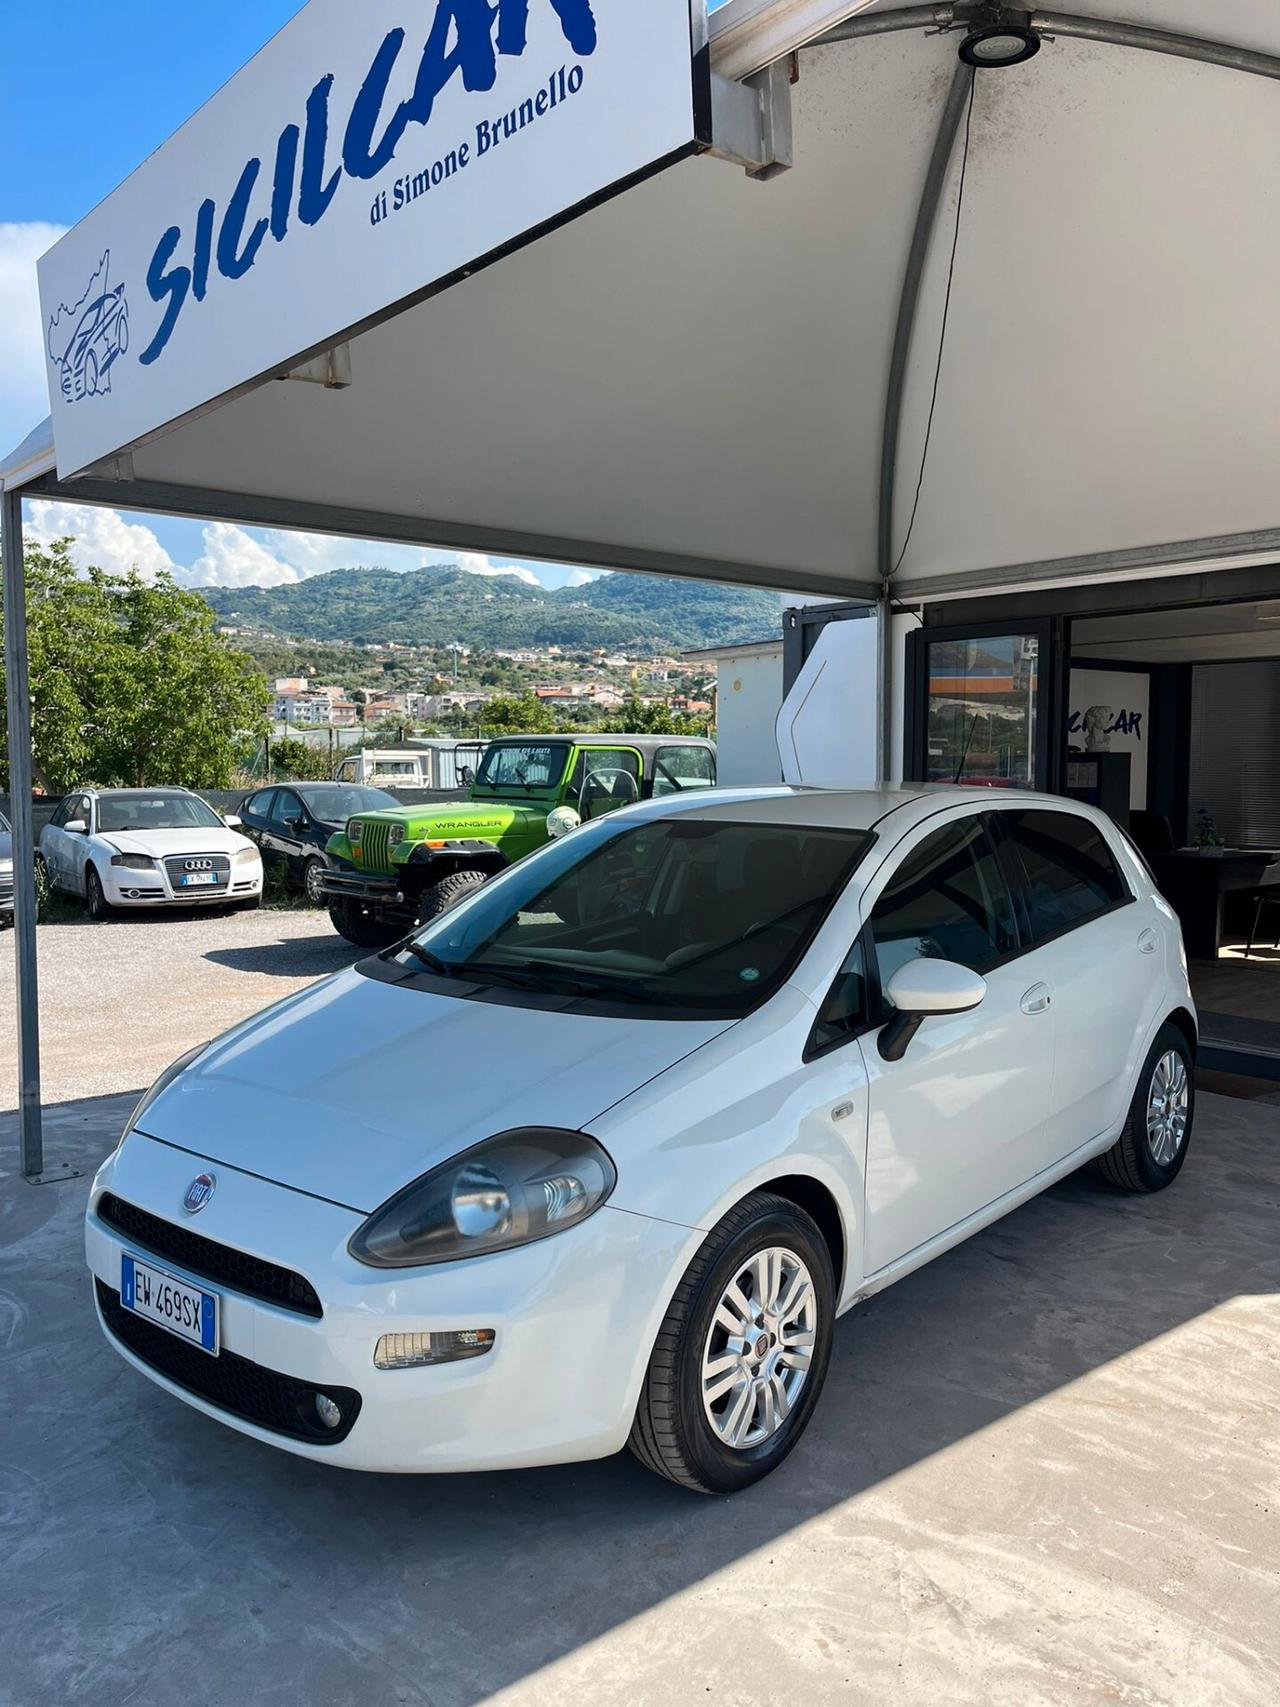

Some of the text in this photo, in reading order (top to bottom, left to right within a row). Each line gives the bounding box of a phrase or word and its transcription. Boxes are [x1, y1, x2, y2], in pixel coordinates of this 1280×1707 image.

[370, 65, 584, 226] di Simone Brunello
[434, 819, 502, 829] WRANGLER
[187, 1182, 209, 1202] FIAT
[155, 1283, 201, 1333] 469SX
